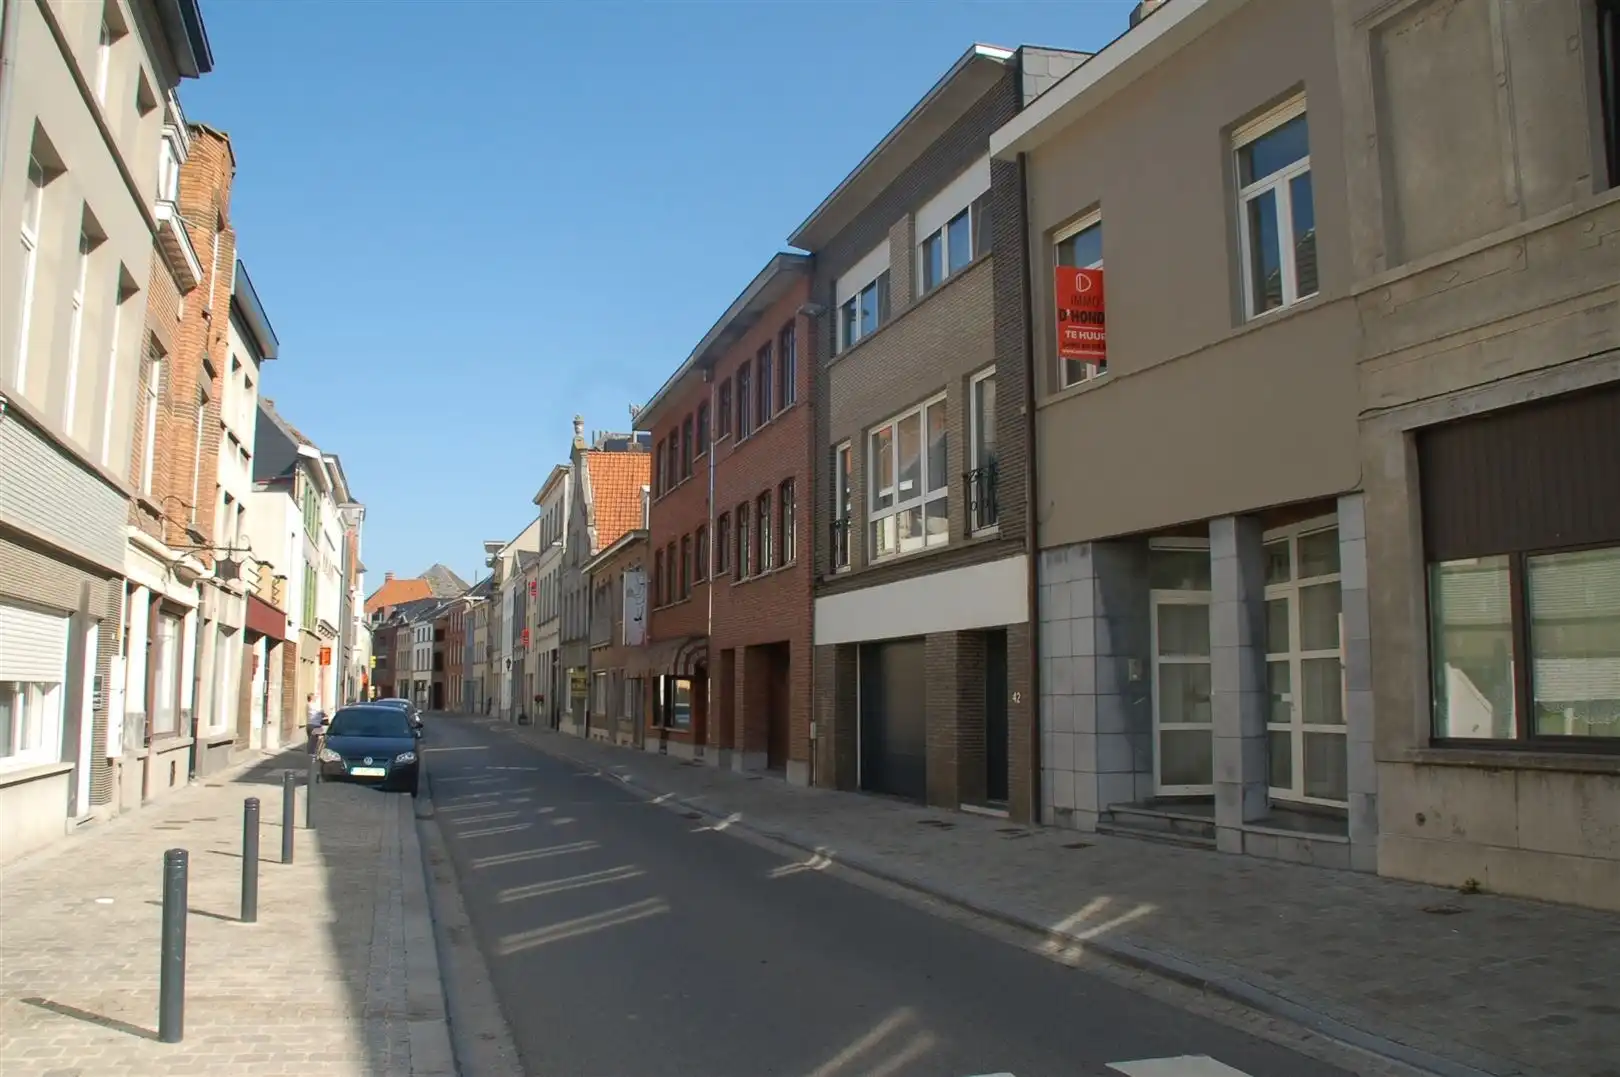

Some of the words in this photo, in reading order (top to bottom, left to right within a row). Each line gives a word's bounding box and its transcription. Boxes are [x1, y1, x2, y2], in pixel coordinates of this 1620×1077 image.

[1071, 295, 1099, 308] IMMO
[1065, 330, 1077, 339] TE
[1012, 691, 1021, 704] 42
